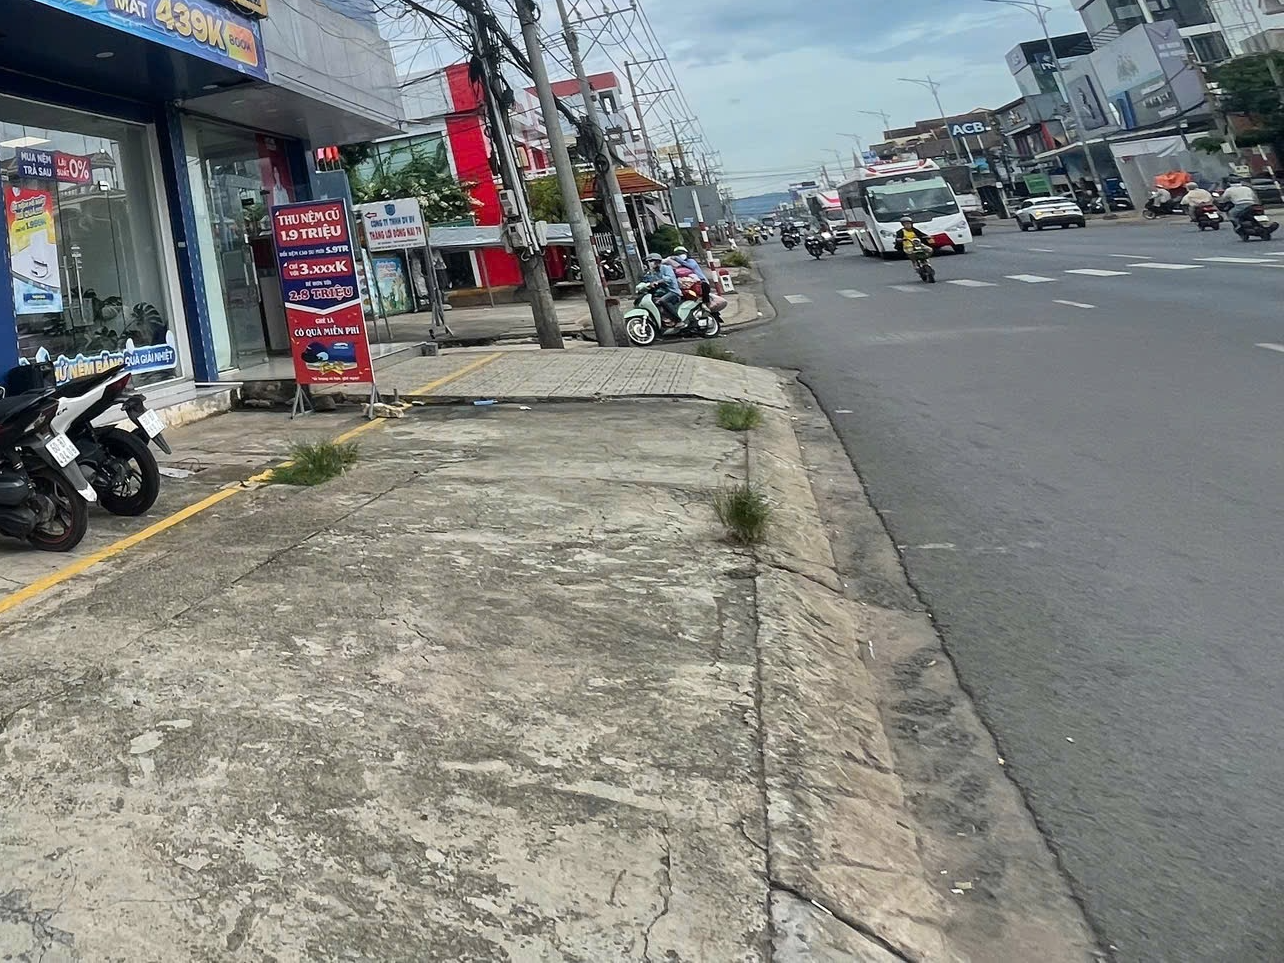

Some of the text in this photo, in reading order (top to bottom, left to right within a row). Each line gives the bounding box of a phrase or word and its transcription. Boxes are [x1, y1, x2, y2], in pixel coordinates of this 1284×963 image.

[952, 121, 986, 136] ACB
[23, 163, 52, 177] TRẢ SAU
[69, 158, 90, 180] 0%
[277, 214, 300, 226] THU
[301, 210, 325, 225] NỆM
[280, 223, 342, 241] 1.9 TRIỆU
[311, 284, 353, 301] TRIỆU
[305, 326, 323, 337] QUÀ
[124, 355, 141, 366] QUÀ
